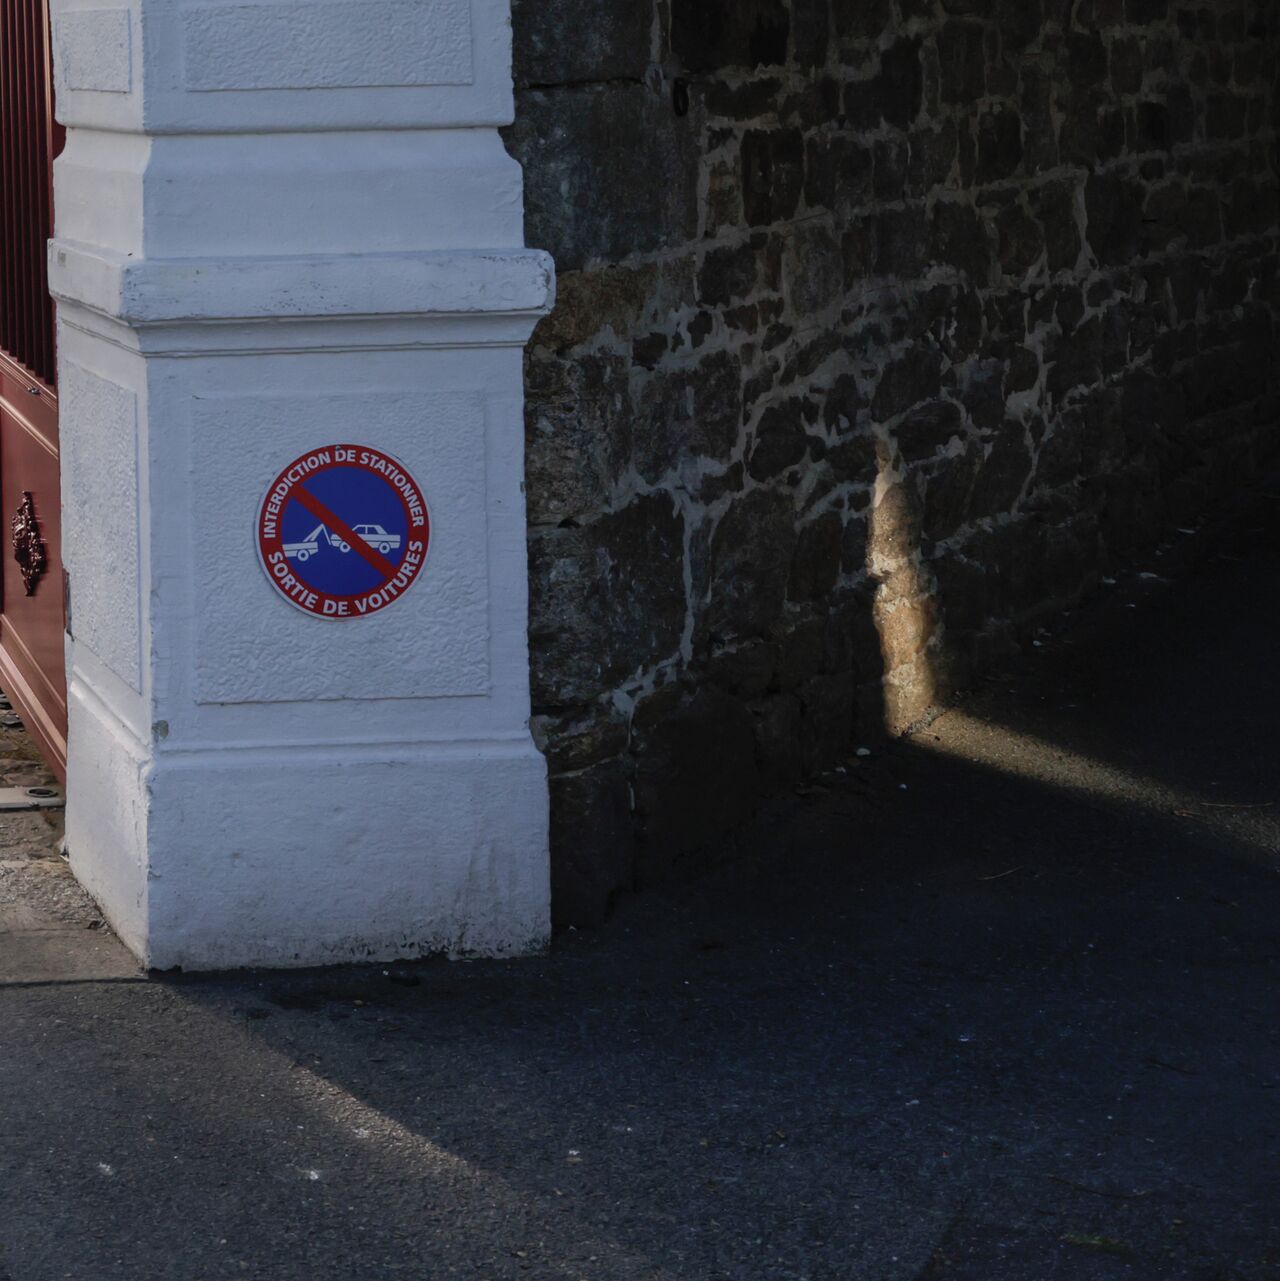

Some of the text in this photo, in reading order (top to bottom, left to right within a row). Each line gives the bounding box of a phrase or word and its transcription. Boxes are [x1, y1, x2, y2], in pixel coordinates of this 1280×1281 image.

[263, 449, 425, 539] INTERDICTION DE STATIONNER
[268, 540, 423, 616] SORTIE DE VOITURES
